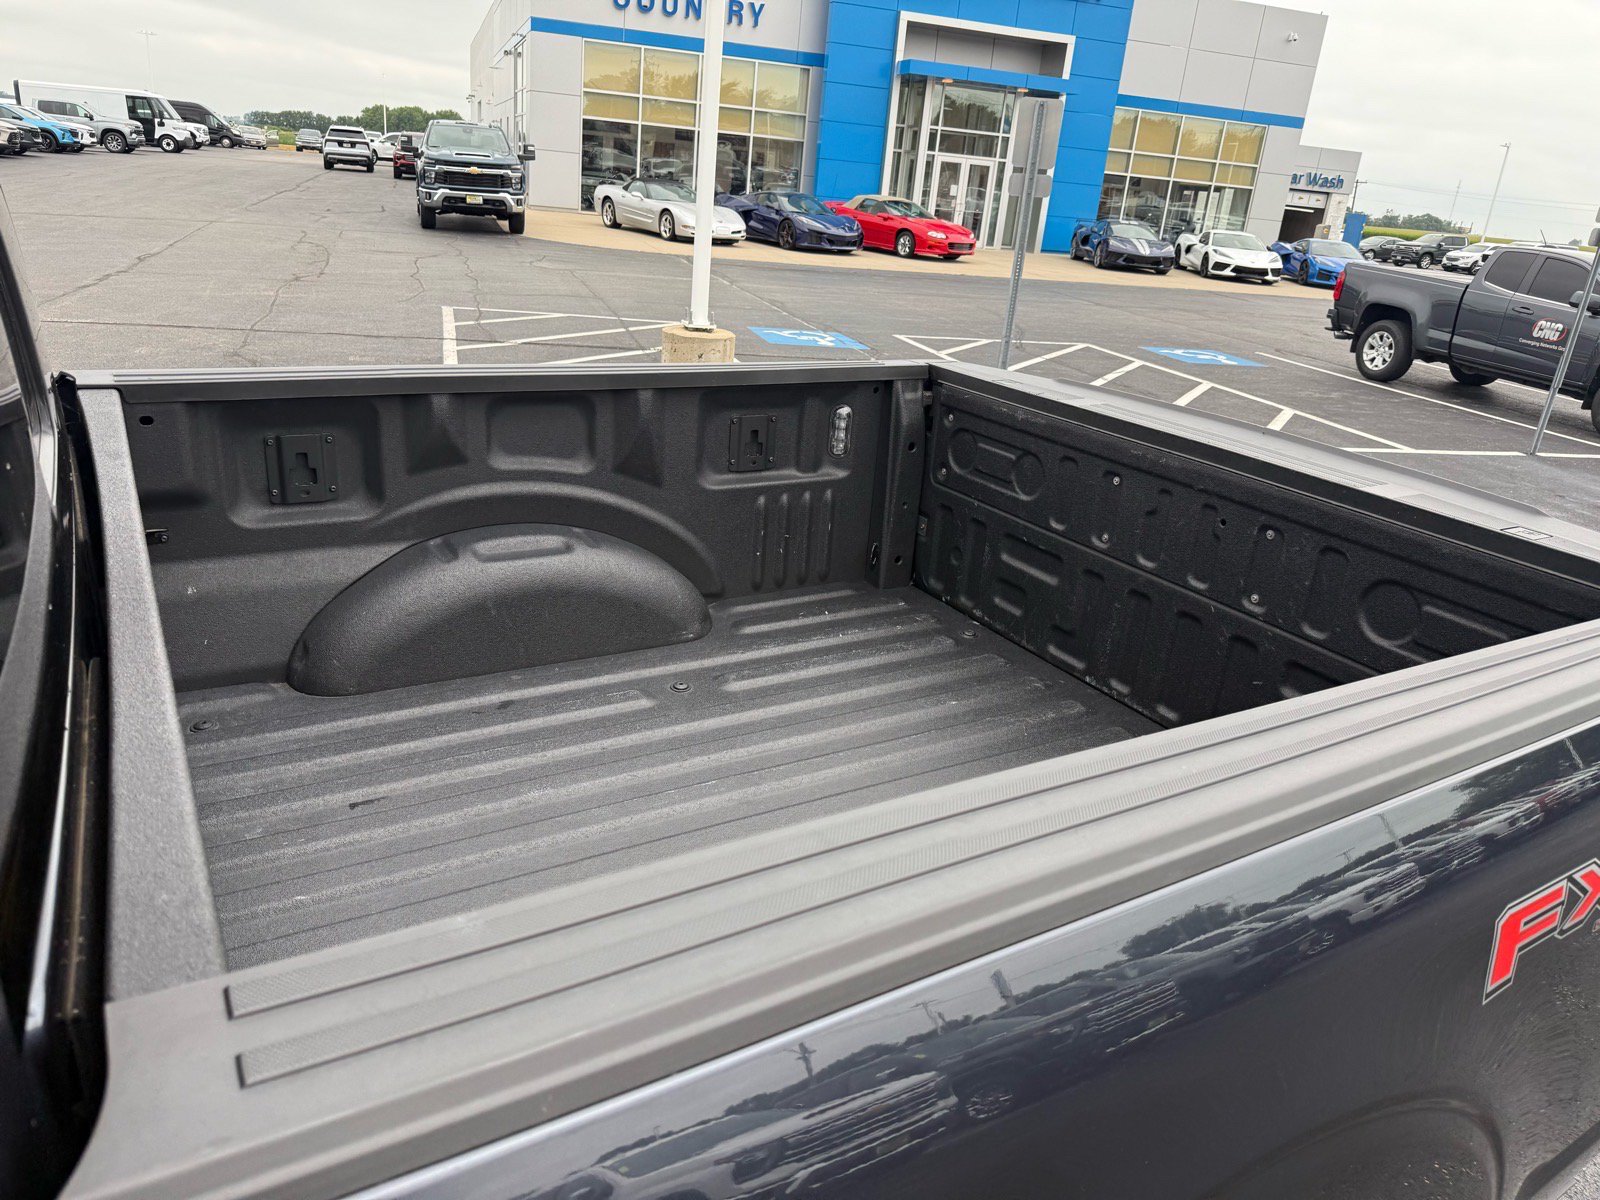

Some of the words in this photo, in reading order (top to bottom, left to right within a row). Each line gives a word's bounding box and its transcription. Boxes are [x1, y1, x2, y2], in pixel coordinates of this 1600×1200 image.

[612, 0, 765, 28] OUNRY
[1291, 173, 1305, 185] ar
[1307, 172, 1344, 189] Wash
[1532, 320, 1564, 340] CNG
